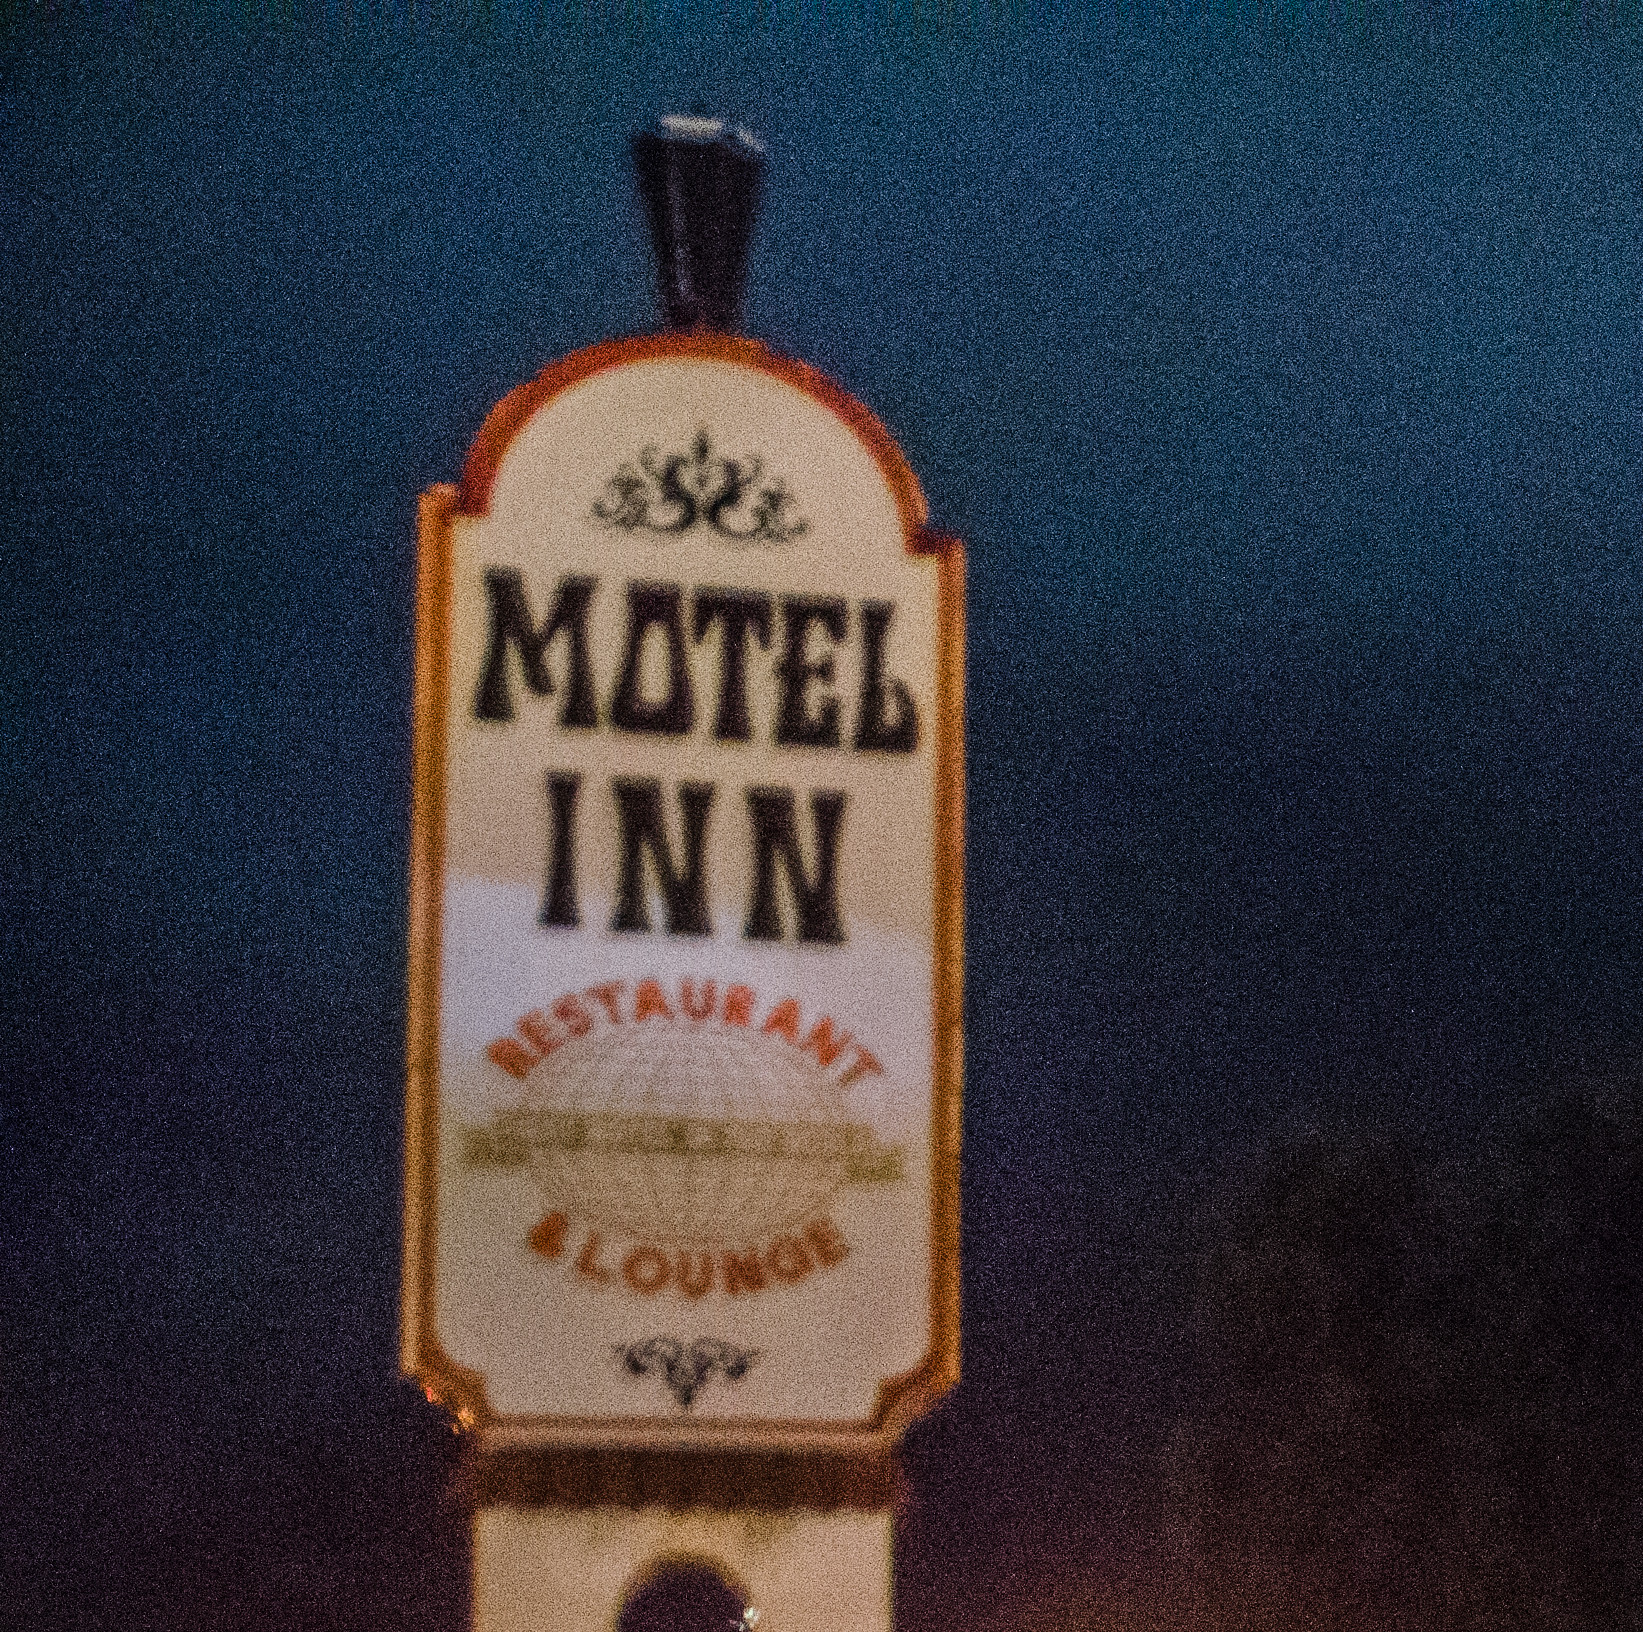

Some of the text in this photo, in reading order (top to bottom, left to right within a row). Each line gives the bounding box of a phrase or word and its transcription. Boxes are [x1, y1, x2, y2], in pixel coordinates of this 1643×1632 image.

[474, 563, 921, 754] MOTEL
[539, 769, 848, 944] INN
[486, 978, 885, 1087] RESTAURANT
